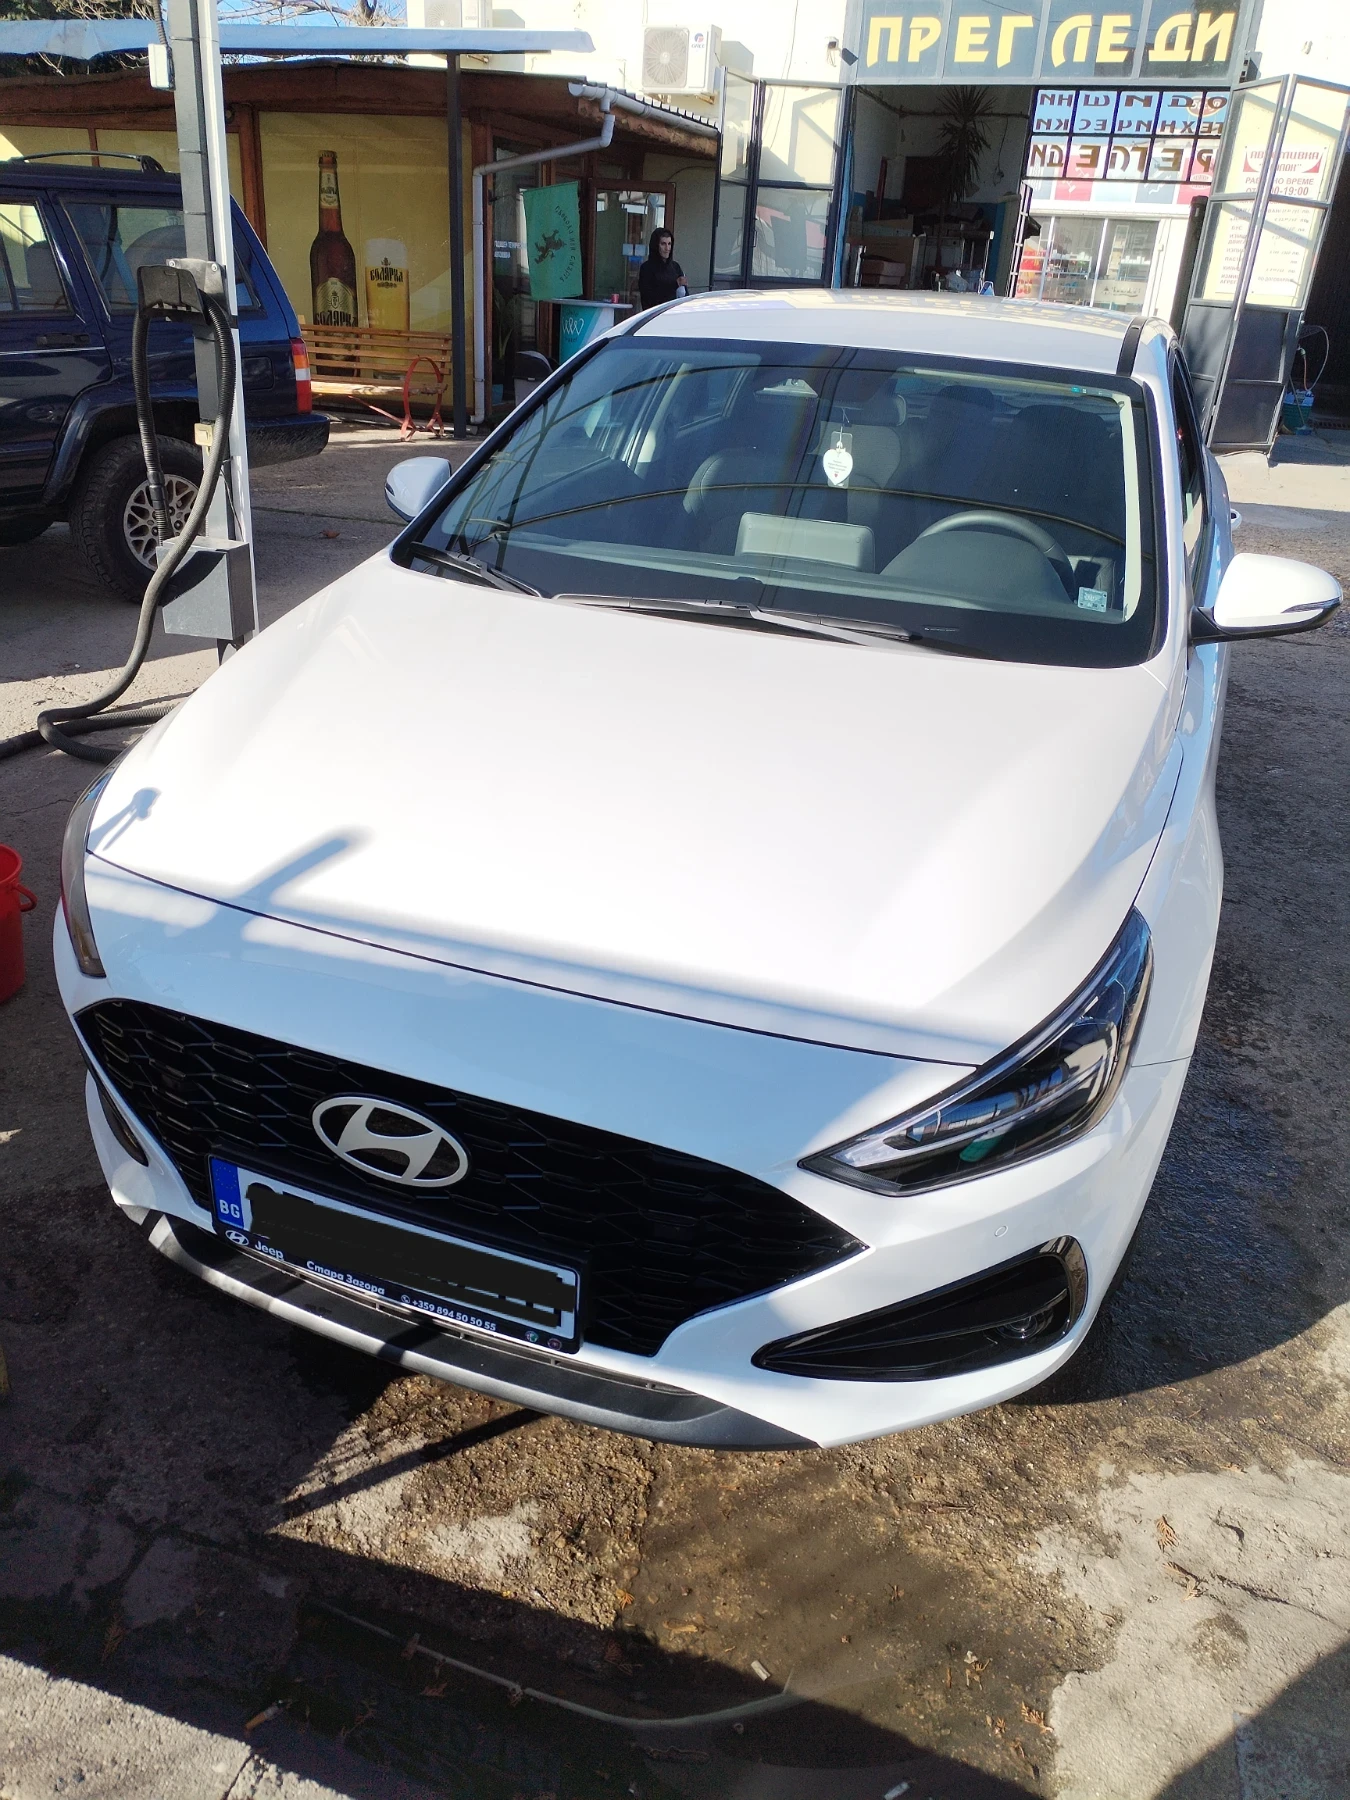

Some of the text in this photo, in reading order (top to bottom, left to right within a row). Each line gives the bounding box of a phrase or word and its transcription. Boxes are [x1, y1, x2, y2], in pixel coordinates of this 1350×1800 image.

[866, 12, 1235, 68] ПРЕГЛЕДИ
[219, 1199, 240, 1219] BG
[254, 1240, 285, 1260] Jeep
[306, 1260, 386, 1295] Стара Загора
[412, 1300, 497, 1332] +359 894 50 50 55
